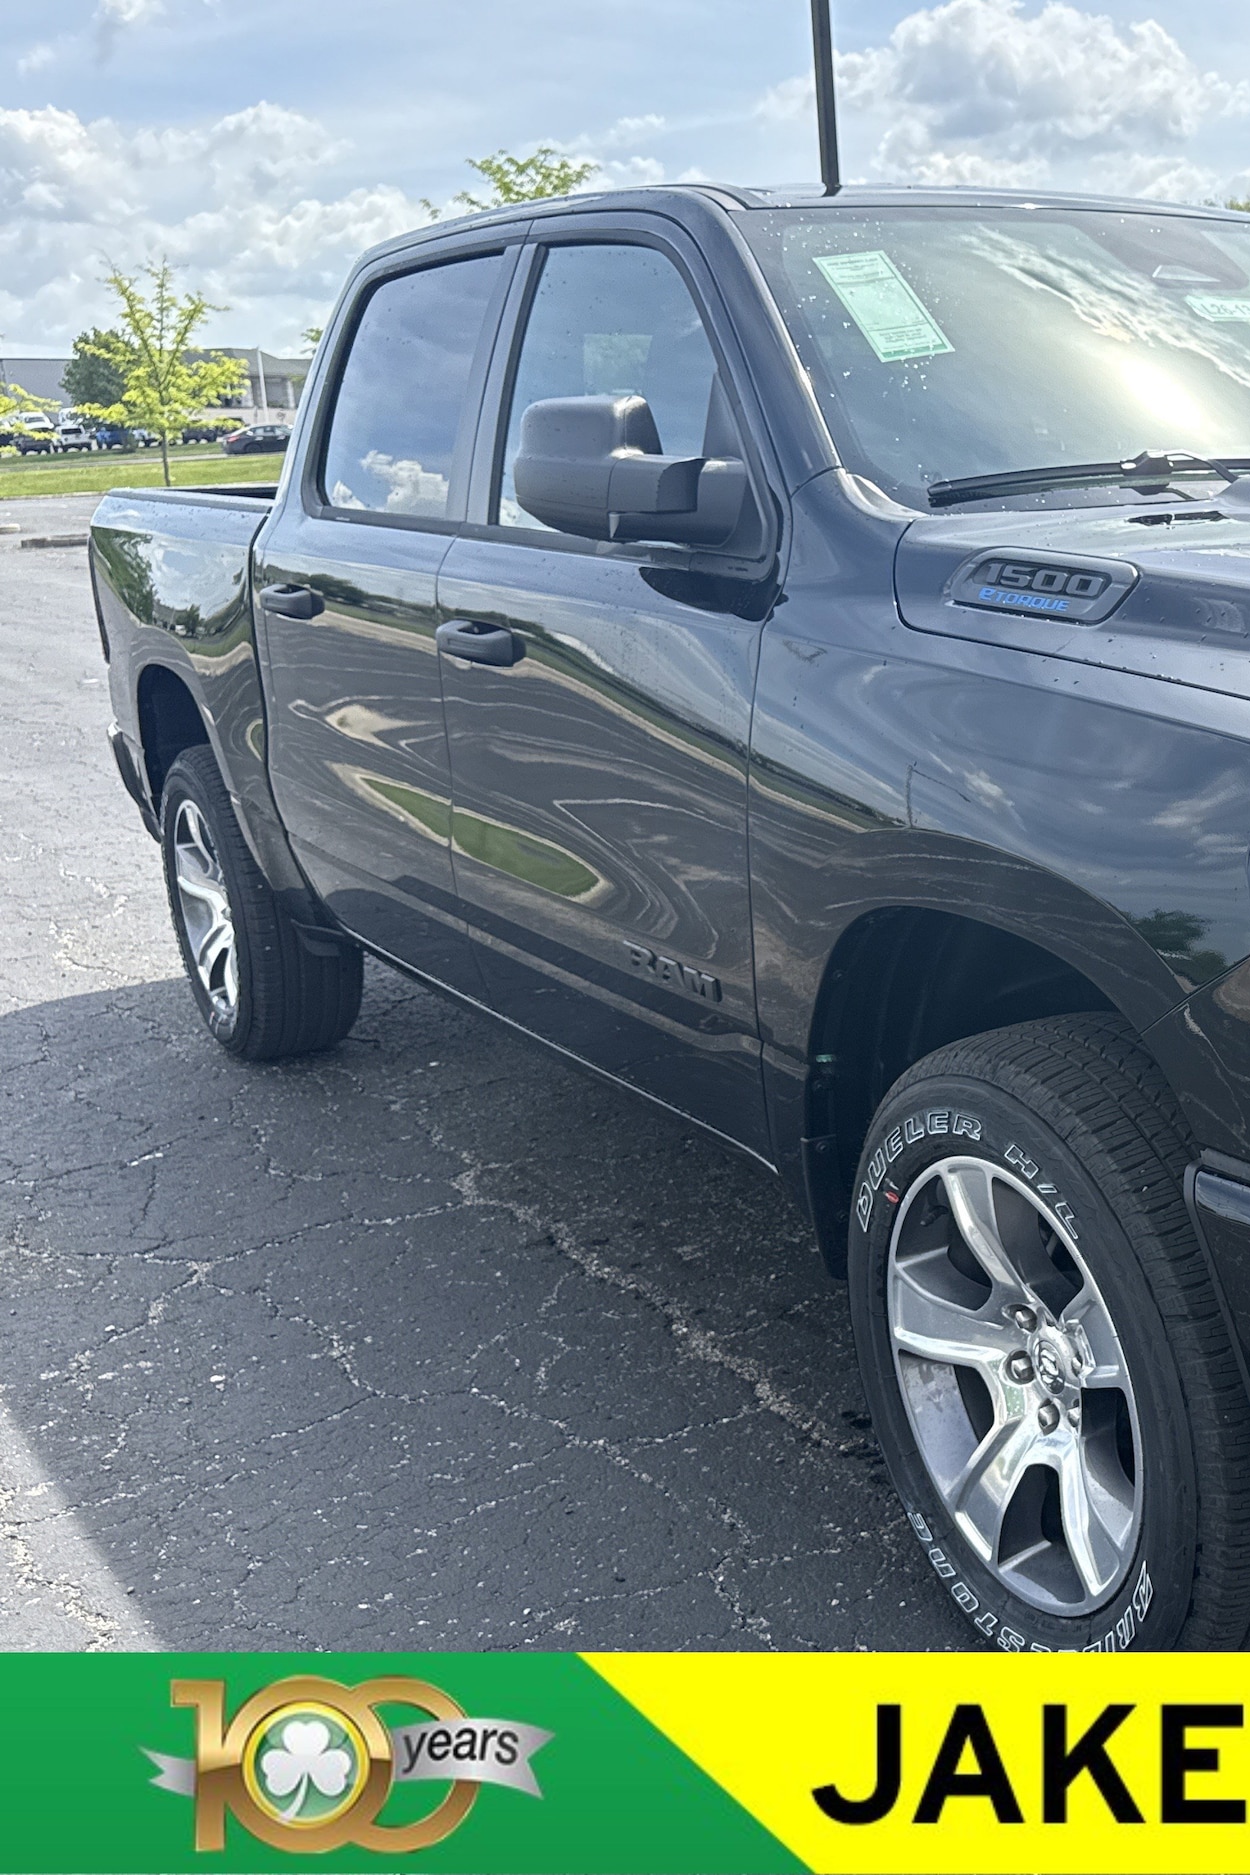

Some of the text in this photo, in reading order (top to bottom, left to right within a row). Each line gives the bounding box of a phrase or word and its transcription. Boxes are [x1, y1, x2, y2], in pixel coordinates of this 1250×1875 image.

[984, 562, 1104, 598] 1500
[622, 940, 722, 1002] RAM
[856, 1110, 1079, 1240] DUELER H/L
[907, 1511, 1153, 1652] BRISTONE
